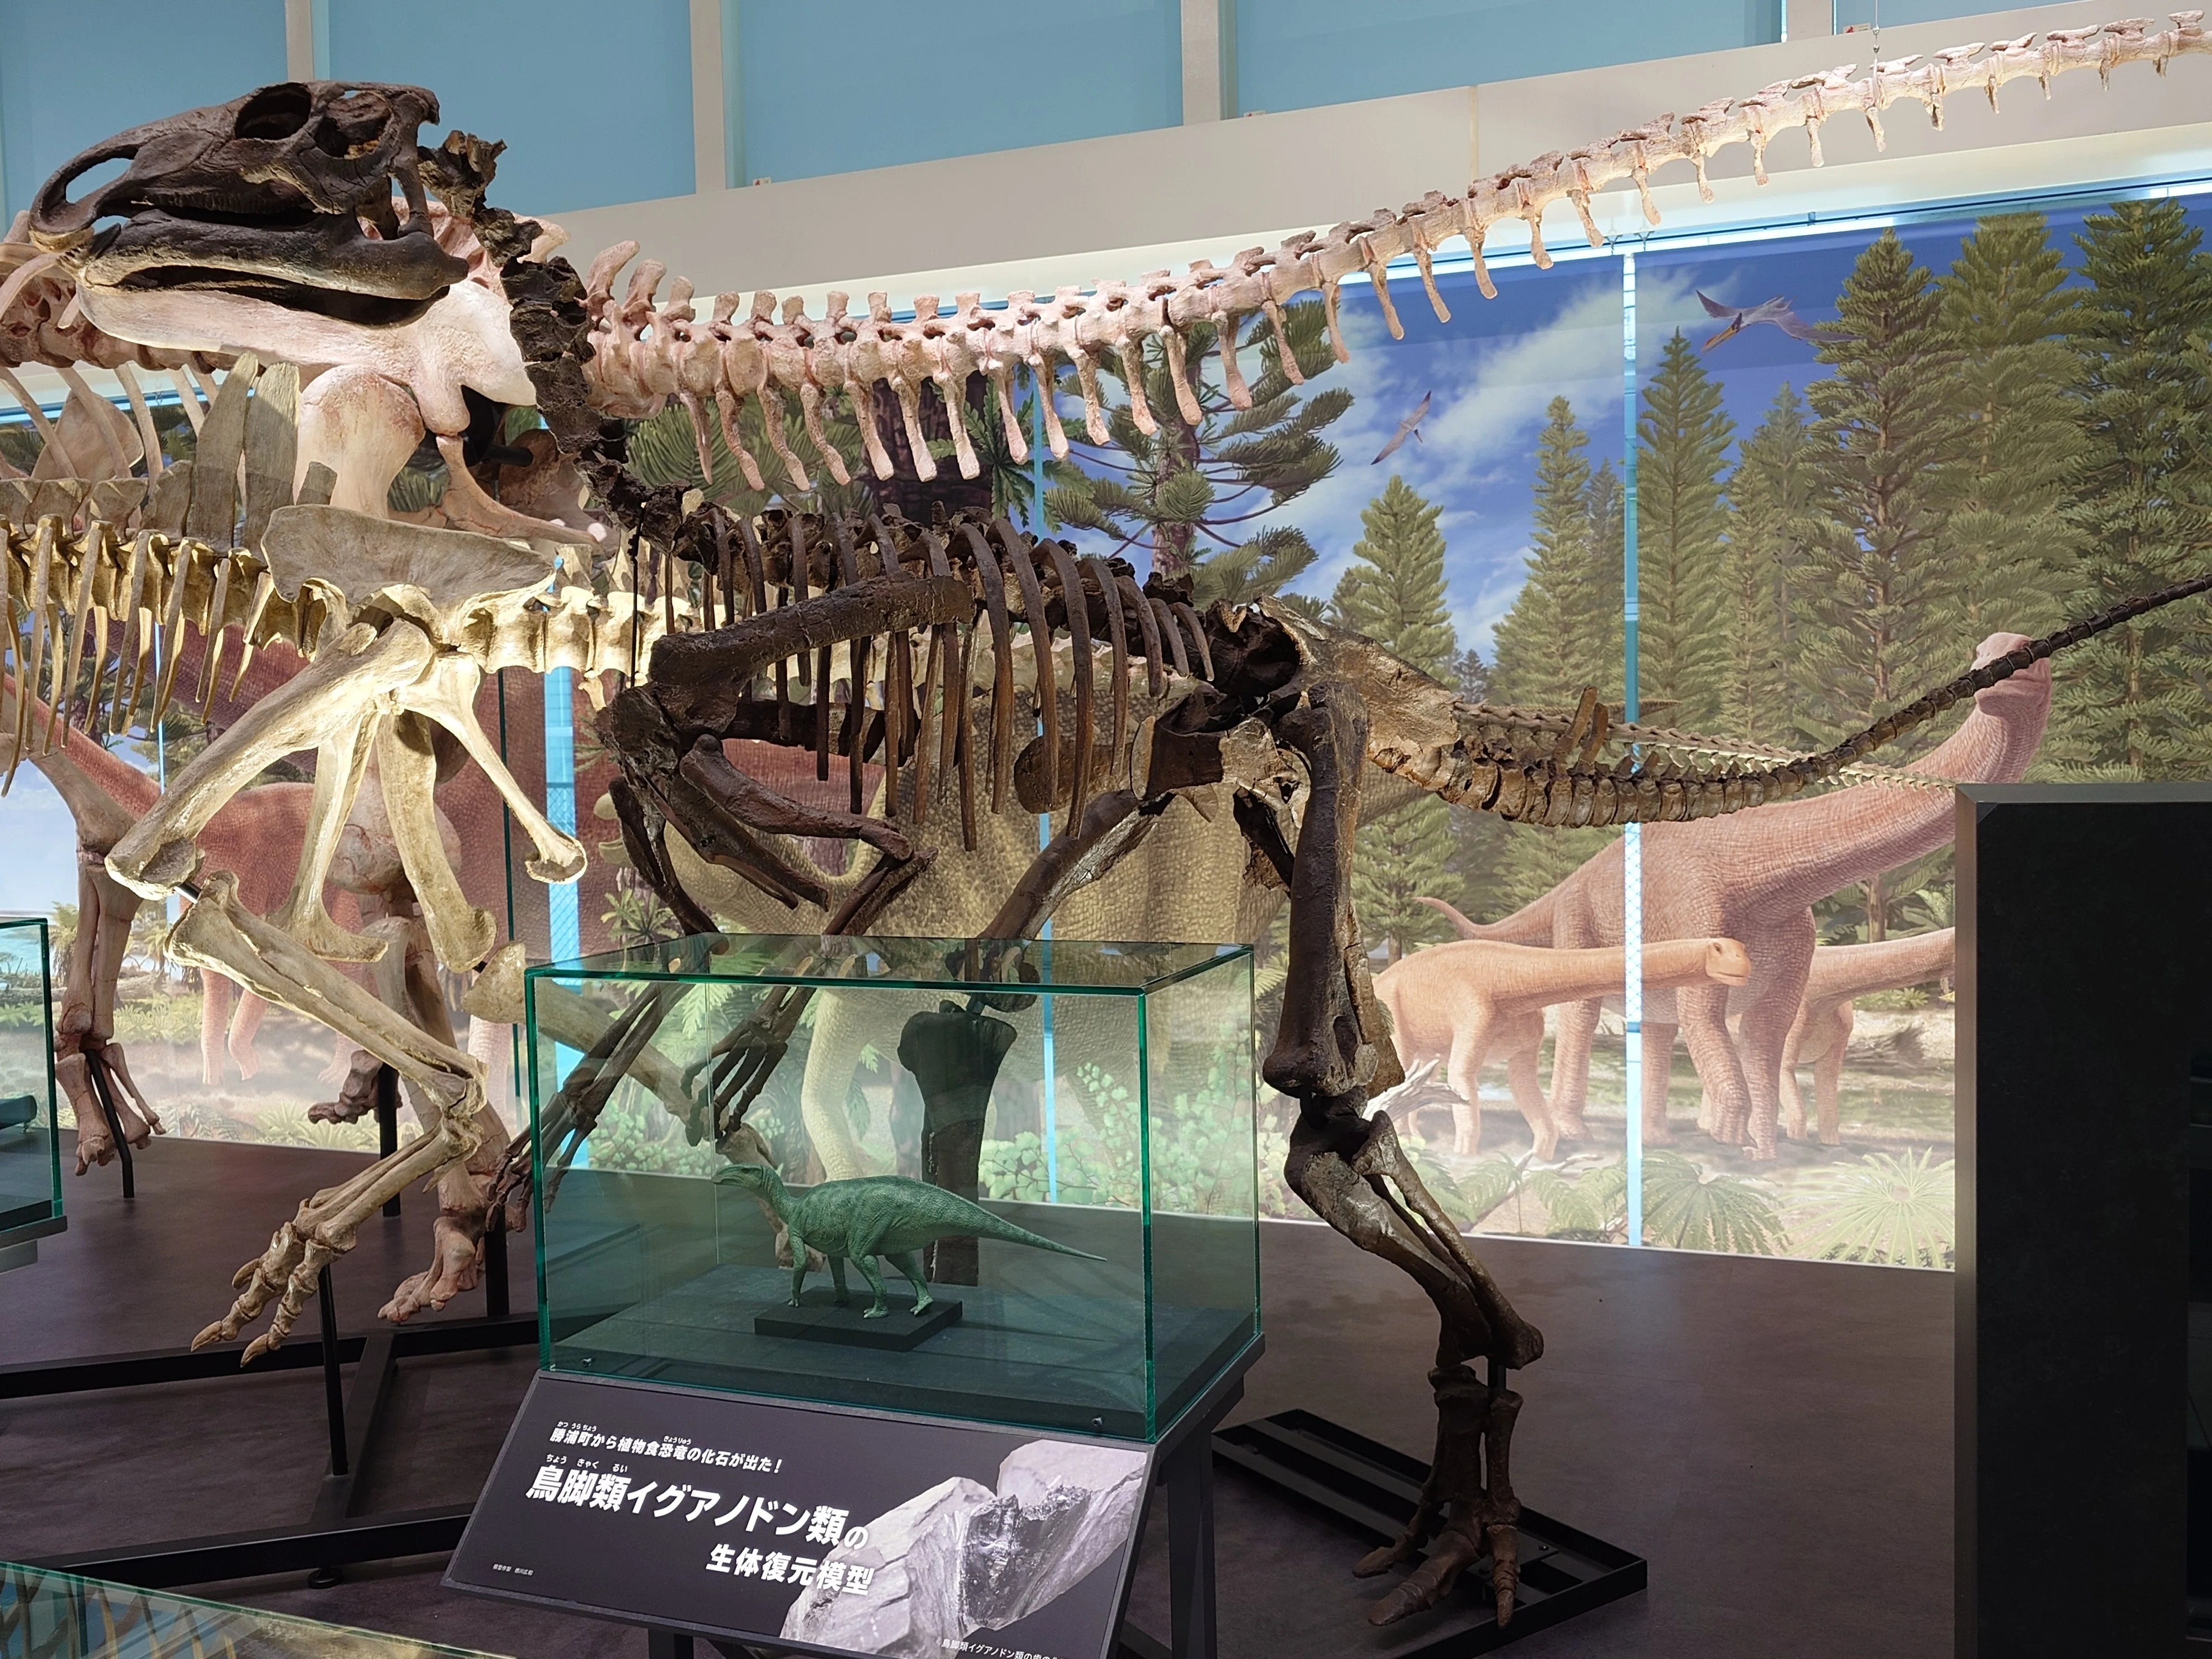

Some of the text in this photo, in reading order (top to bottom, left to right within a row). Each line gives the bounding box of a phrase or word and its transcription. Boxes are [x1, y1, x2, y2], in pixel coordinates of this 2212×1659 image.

[525, 1465, 868, 1550] 鳥脚類イグアノドン類の
[706, 1543, 875, 1595] 生体復元模型
